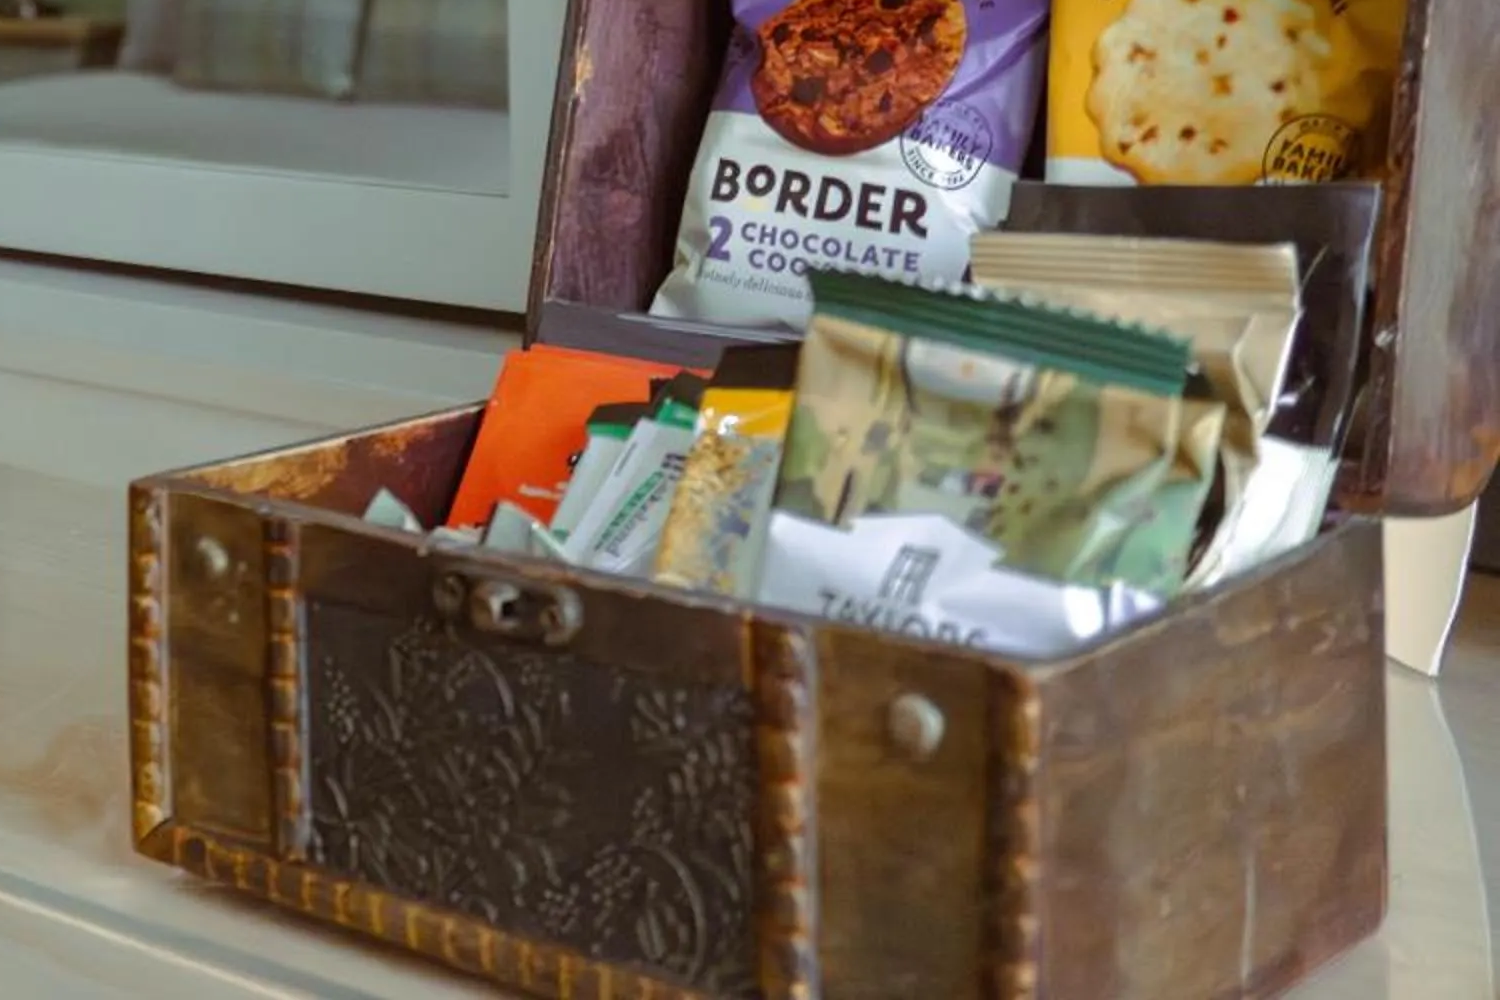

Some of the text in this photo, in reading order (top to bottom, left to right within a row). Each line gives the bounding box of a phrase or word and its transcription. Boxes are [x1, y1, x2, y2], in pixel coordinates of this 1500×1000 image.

[710, 157, 928, 239] BORDER
[705, 215, 733, 262] 2
[740, 222, 922, 273] CHOCOLATE
